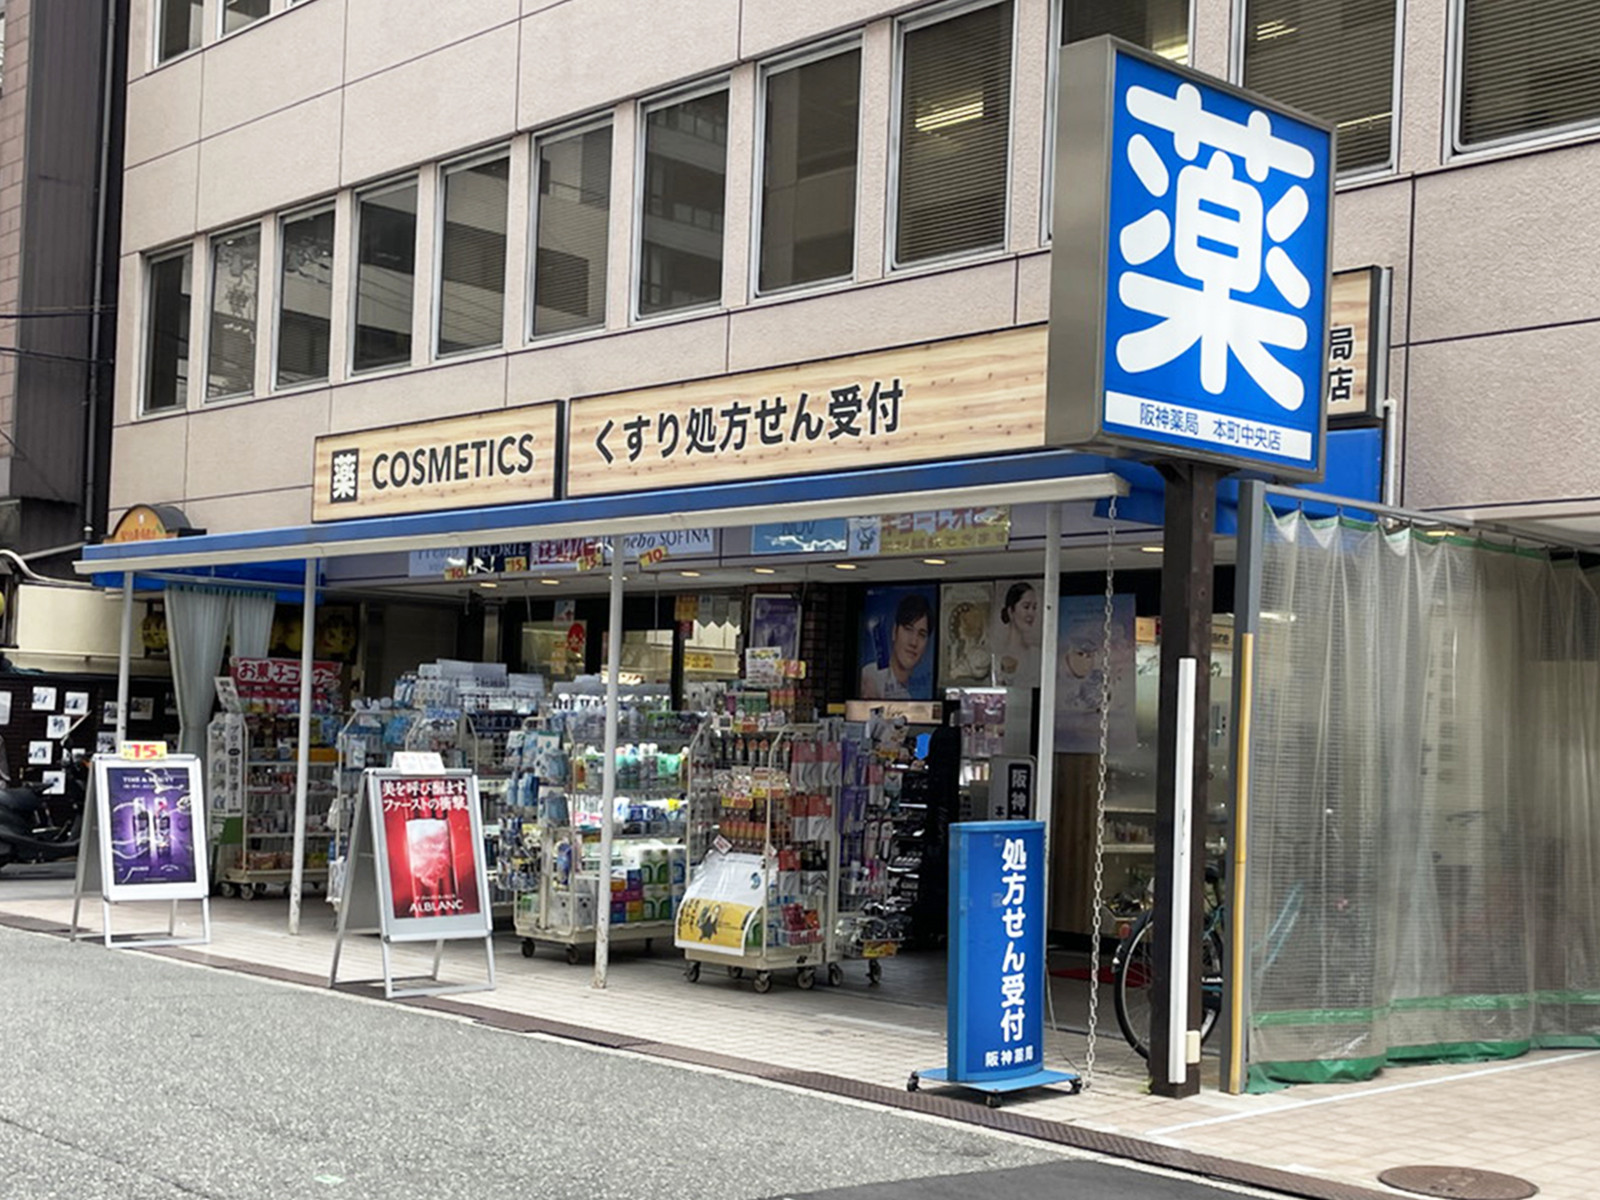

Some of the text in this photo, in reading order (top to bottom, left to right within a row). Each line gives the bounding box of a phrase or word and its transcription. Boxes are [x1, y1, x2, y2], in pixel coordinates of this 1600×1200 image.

[1116, 83, 1315, 411] 薬
[595, 378, 904, 464] くすり処方せん受付
[1139, 402, 1282, 451] 阪神薬局 本町中央店
[331, 434, 534, 501] 薬 COSMETICS
[237, 662, 335, 686] お菓子コナー
[131, 743, 159, 759] 15
[1000, 838, 1028, 1043] 処方せん受付
